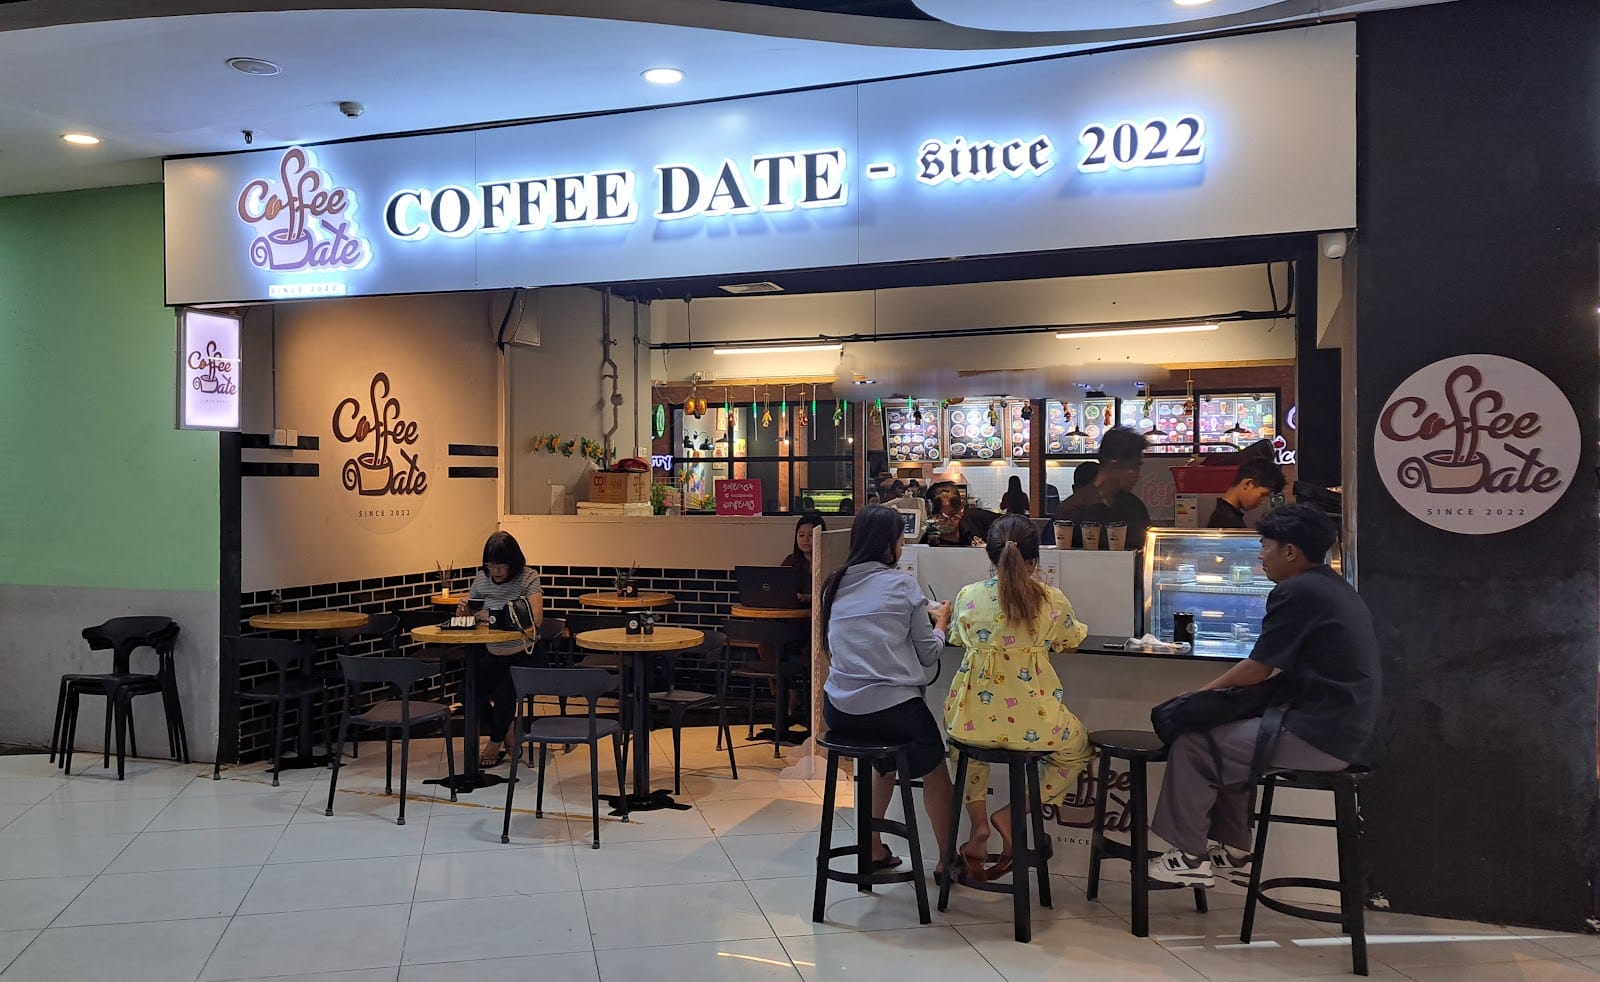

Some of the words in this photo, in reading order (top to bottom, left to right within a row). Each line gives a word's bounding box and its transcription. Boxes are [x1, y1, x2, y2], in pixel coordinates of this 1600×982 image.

[238, 148, 347, 240] Coffee
[386, 171, 631, 240] COFFEE
[655, 149, 845, 216] DATE
[920, 137, 1050, 181] since
[1082, 116, 1203, 167] 2022
[251, 219, 361, 270] Date
[188, 340, 232, 381] Coffee
[193, 374, 237, 395] Date
[332, 372, 419, 468] Coffee
[1380, 365, 1541, 464] Coffee
[342, 449, 428, 496] Date
[1397, 443, 1562, 494] Date
[359, 510, 385, 518] SINCE
[391, 509, 411, 517] 2022
[1427, 508, 1475, 516] SINCE
[1486, 508, 1526, 516] 2022
[1057, 836, 1090, 845] SINCE
